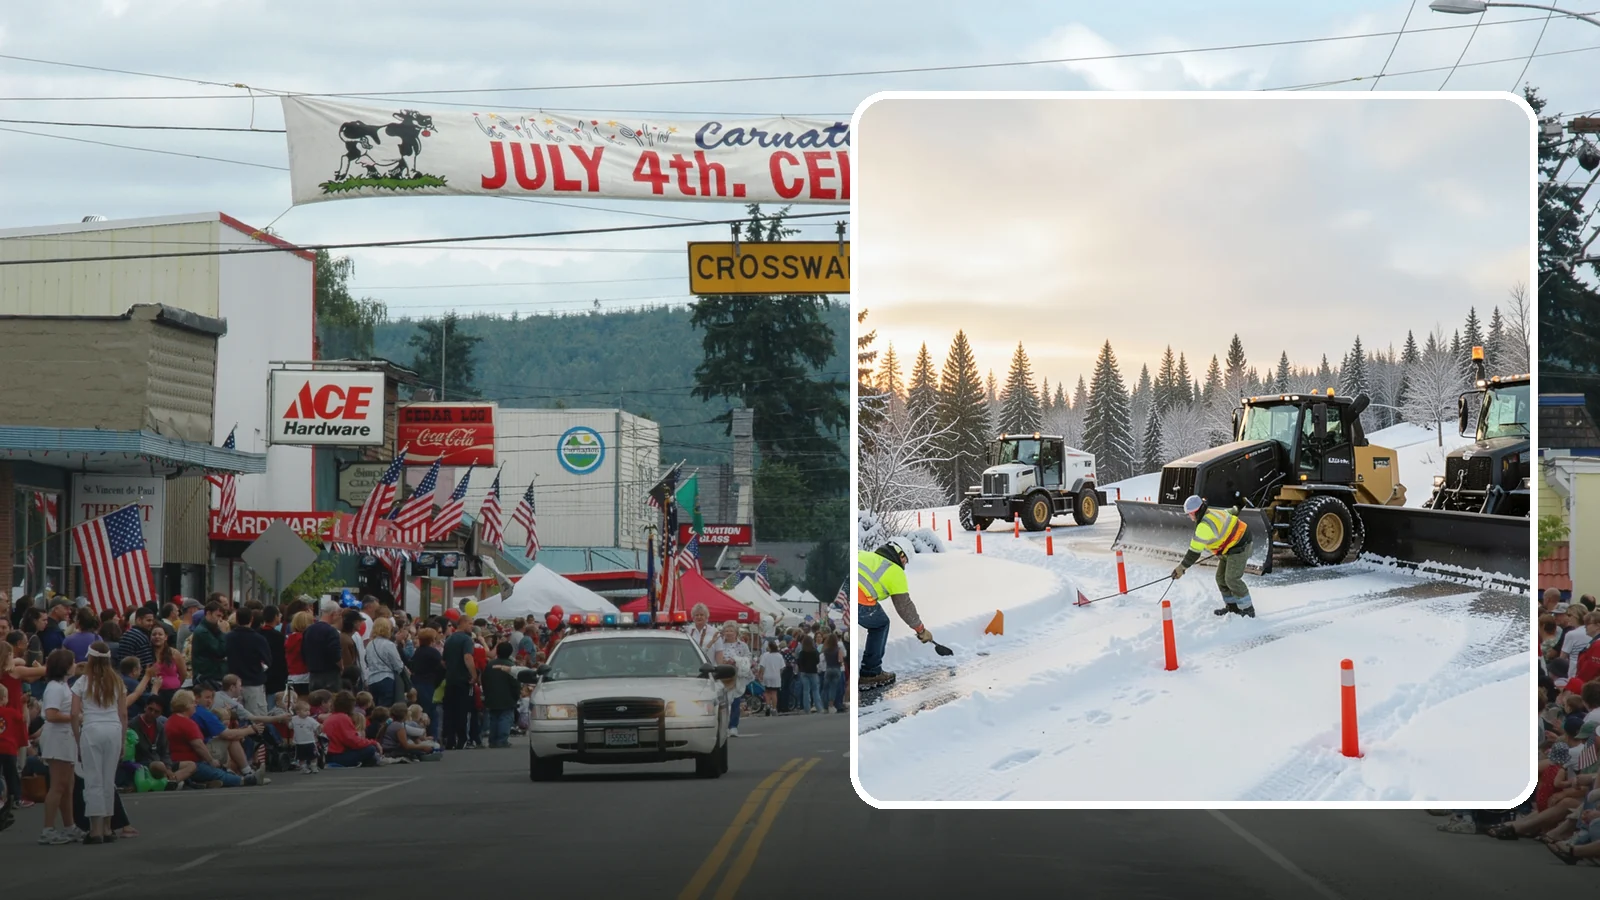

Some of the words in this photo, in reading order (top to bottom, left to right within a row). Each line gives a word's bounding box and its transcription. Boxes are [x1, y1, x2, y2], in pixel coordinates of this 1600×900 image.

[481, 140, 605, 193] JULY
[632, 150, 746, 199] 4th.
[696, 254, 850, 280] CROSSWA
[283, 380, 373, 419] ACE
[405, 409, 452, 422] CEDAR
[461, 410, 485, 422] LOG
[283, 421, 370, 436] Hardware
[416, 427, 477, 447] Coca-Cola
[353, 467, 385, 482] Simpl
[83, 485, 93, 494] St.
[96, 485, 124, 495] Vincent
[126, 485, 136, 495] de
[137, 486, 155, 495] Paul
[81, 503, 154, 522] THT
[212, 516, 330, 535] HARDARE
[688, 526, 741, 535] CRNATION
[699, 535, 731, 543] GLASS
